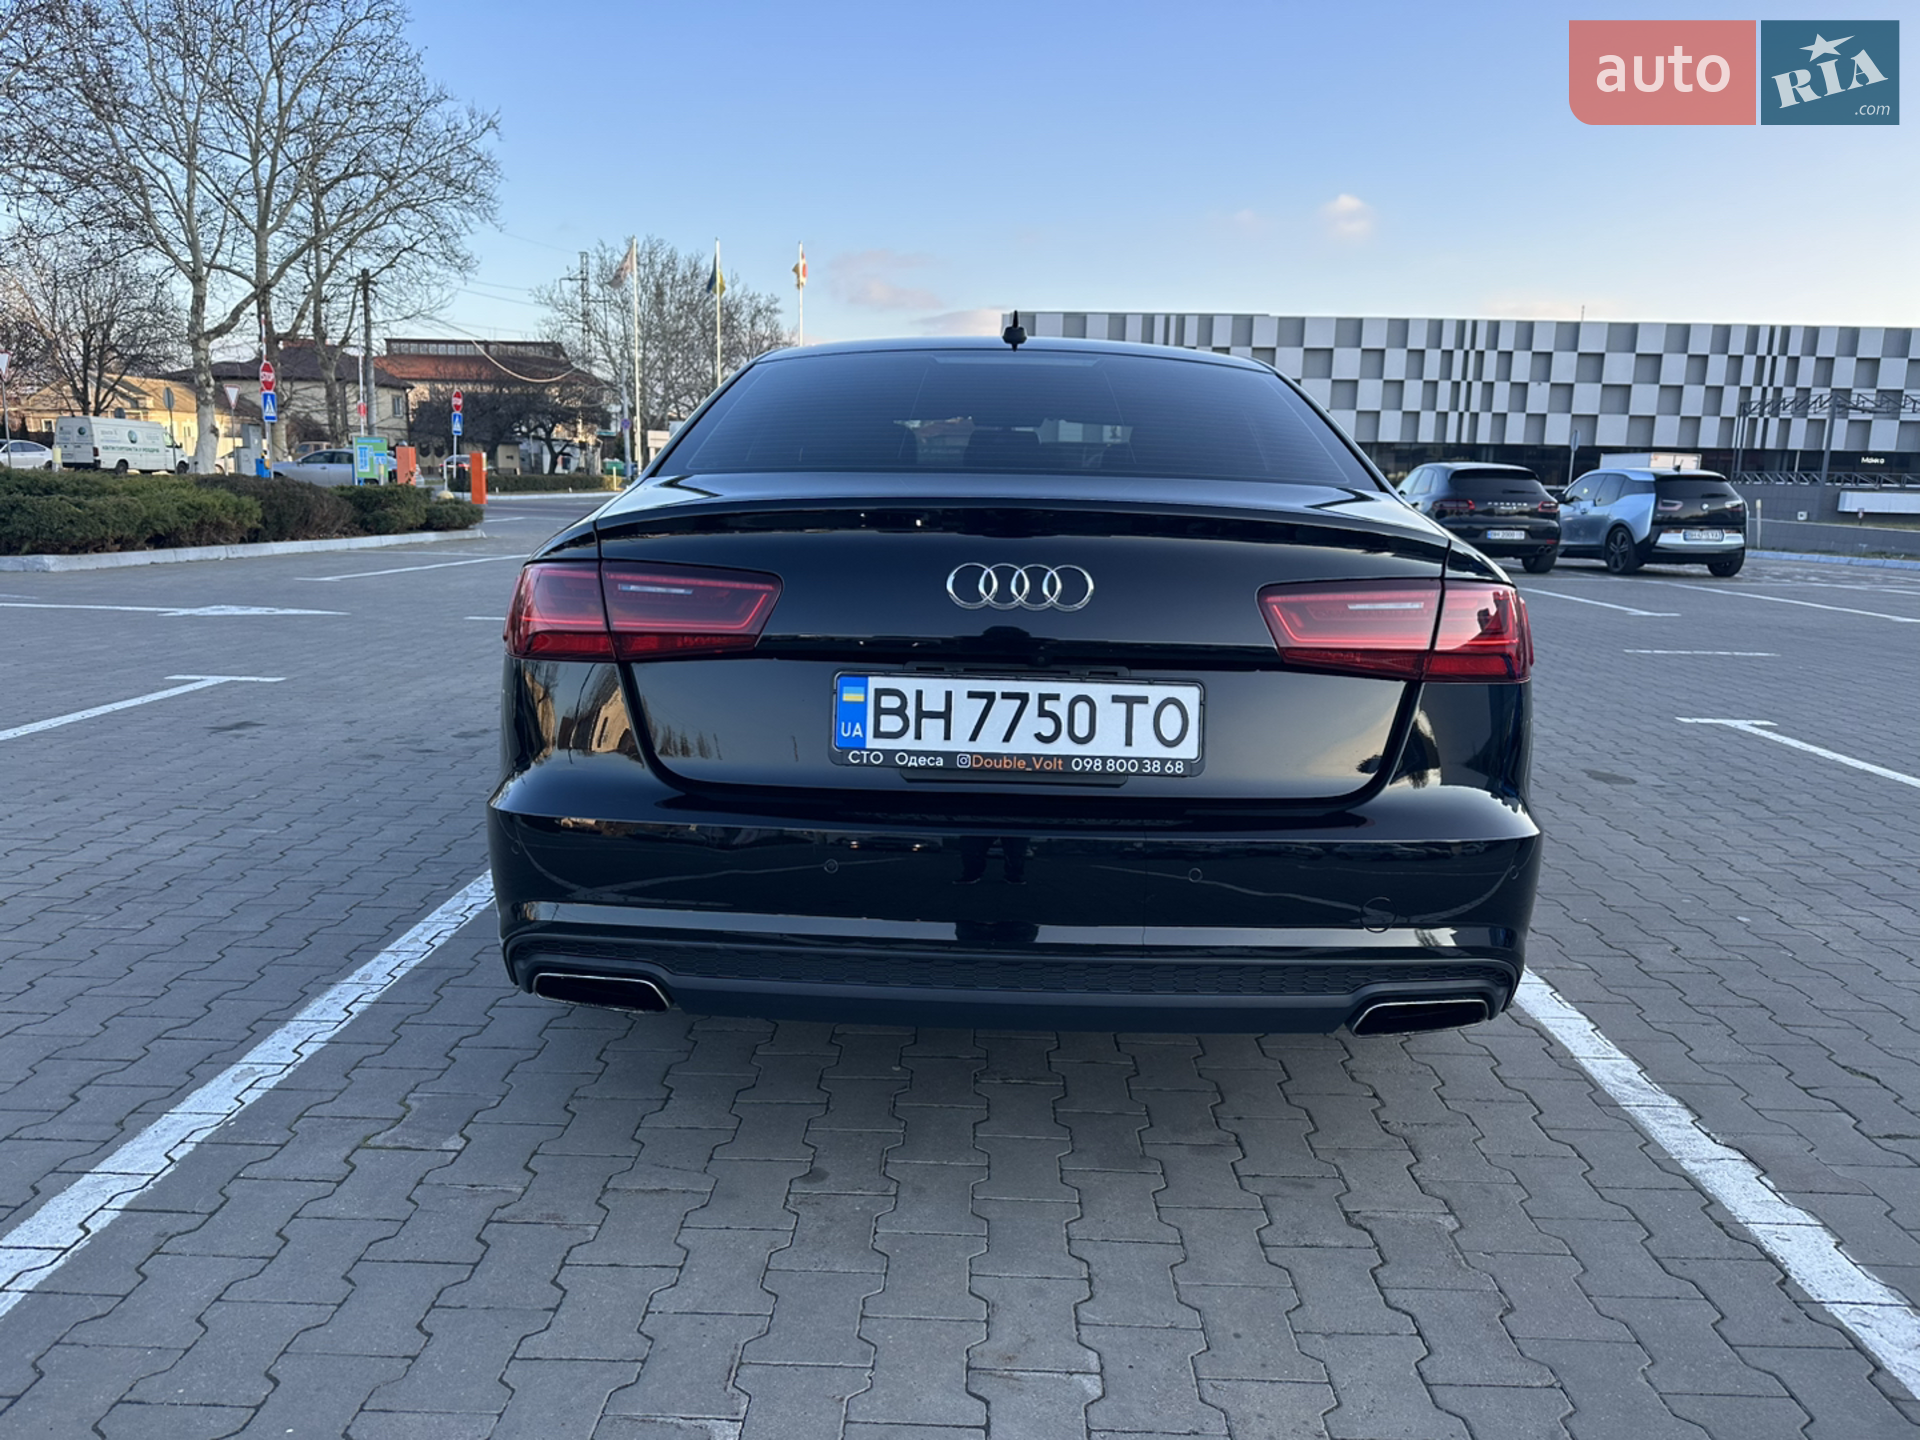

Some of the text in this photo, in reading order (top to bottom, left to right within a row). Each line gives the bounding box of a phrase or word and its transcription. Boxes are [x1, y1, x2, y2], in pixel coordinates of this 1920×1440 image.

[841, 721, 863, 738] UA
[872, 688, 1190, 748] BH 7750 TO
[848, 750, 1184, 774] СТО Одеса Double_Volt 098 800 38 68
